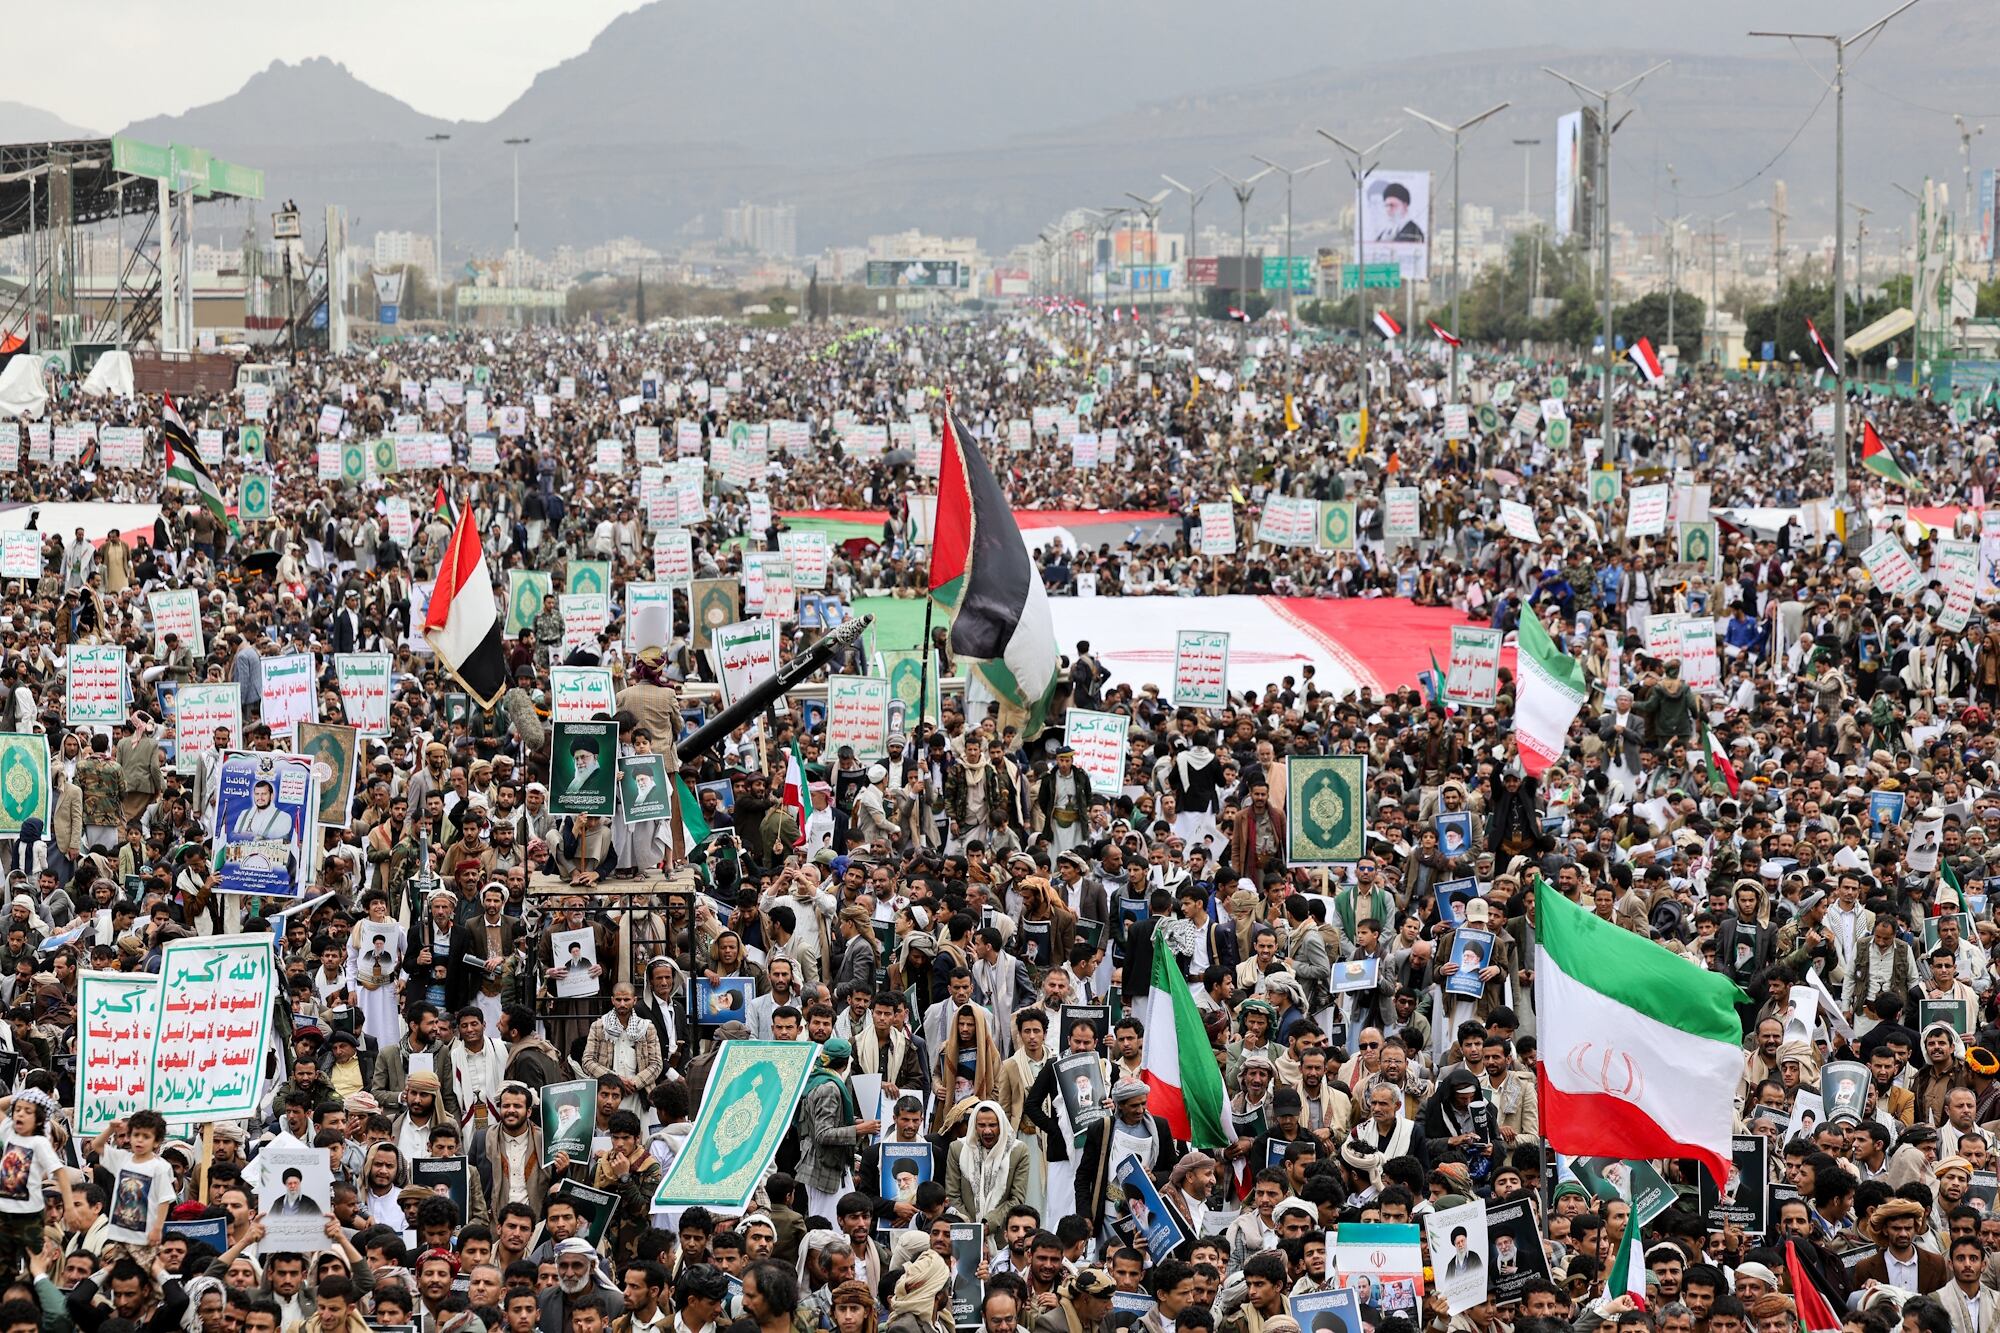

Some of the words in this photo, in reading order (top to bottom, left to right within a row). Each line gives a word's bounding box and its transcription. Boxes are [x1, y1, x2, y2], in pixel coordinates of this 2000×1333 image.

[720, 624, 770, 651] قاطعوا
[74, 648, 102, 663] أكبر
[102, 651, 120, 660] الله
[558, 675, 586, 696] أكبر
[588, 679, 607, 692] الله
[169, 951, 228, 992] أكبر
[229, 953, 266, 981] الله
[89, 985, 146, 1019] أكبر
[166, 991, 217, 1014] لأمريكا
[220, 992, 262, 1013] الموت
[89, 1020, 139, 1042] لأمريكا
[161, 1022, 214, 1044] لإسرائيل
[217, 1021, 258, 1042] الموت
[88, 1048, 139, 1070] لإسرائيل
[157, 1051, 194, 1072] اليهود
[199, 1050, 217, 1072] على
[222, 1048, 255, 1065] اللعنة
[87, 1076, 122, 1094] اليهود
[155, 1073, 205, 1108] للإسلام
[208, 1072, 250, 1105] النصر
